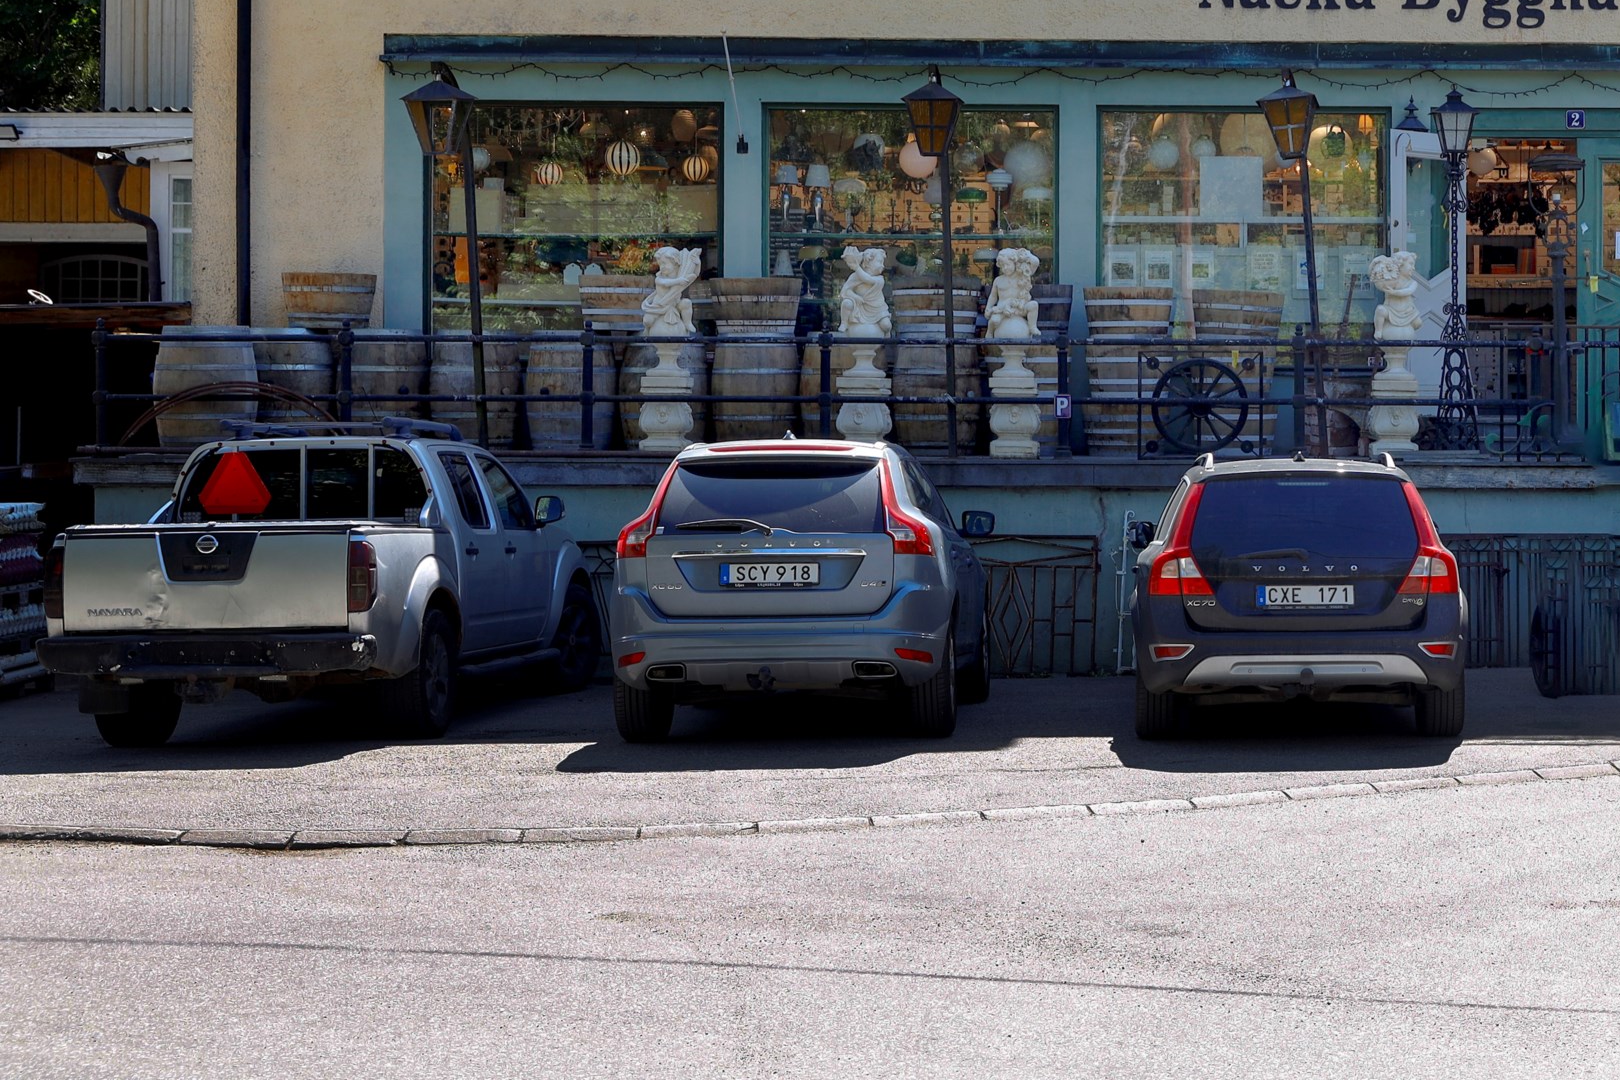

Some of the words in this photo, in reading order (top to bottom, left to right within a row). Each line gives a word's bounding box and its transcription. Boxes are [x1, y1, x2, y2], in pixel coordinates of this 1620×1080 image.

[1571, 112, 1580, 126] 2
[1056, 397, 1069, 416] P
[736, 565, 770, 582] SCY
[776, 565, 811, 581] 918
[1268, 586, 1302, 604] CXE
[1318, 586, 1349, 603] 171
[1187, 599, 1216, 607] XC70
[87, 608, 143, 617] NAVARA
